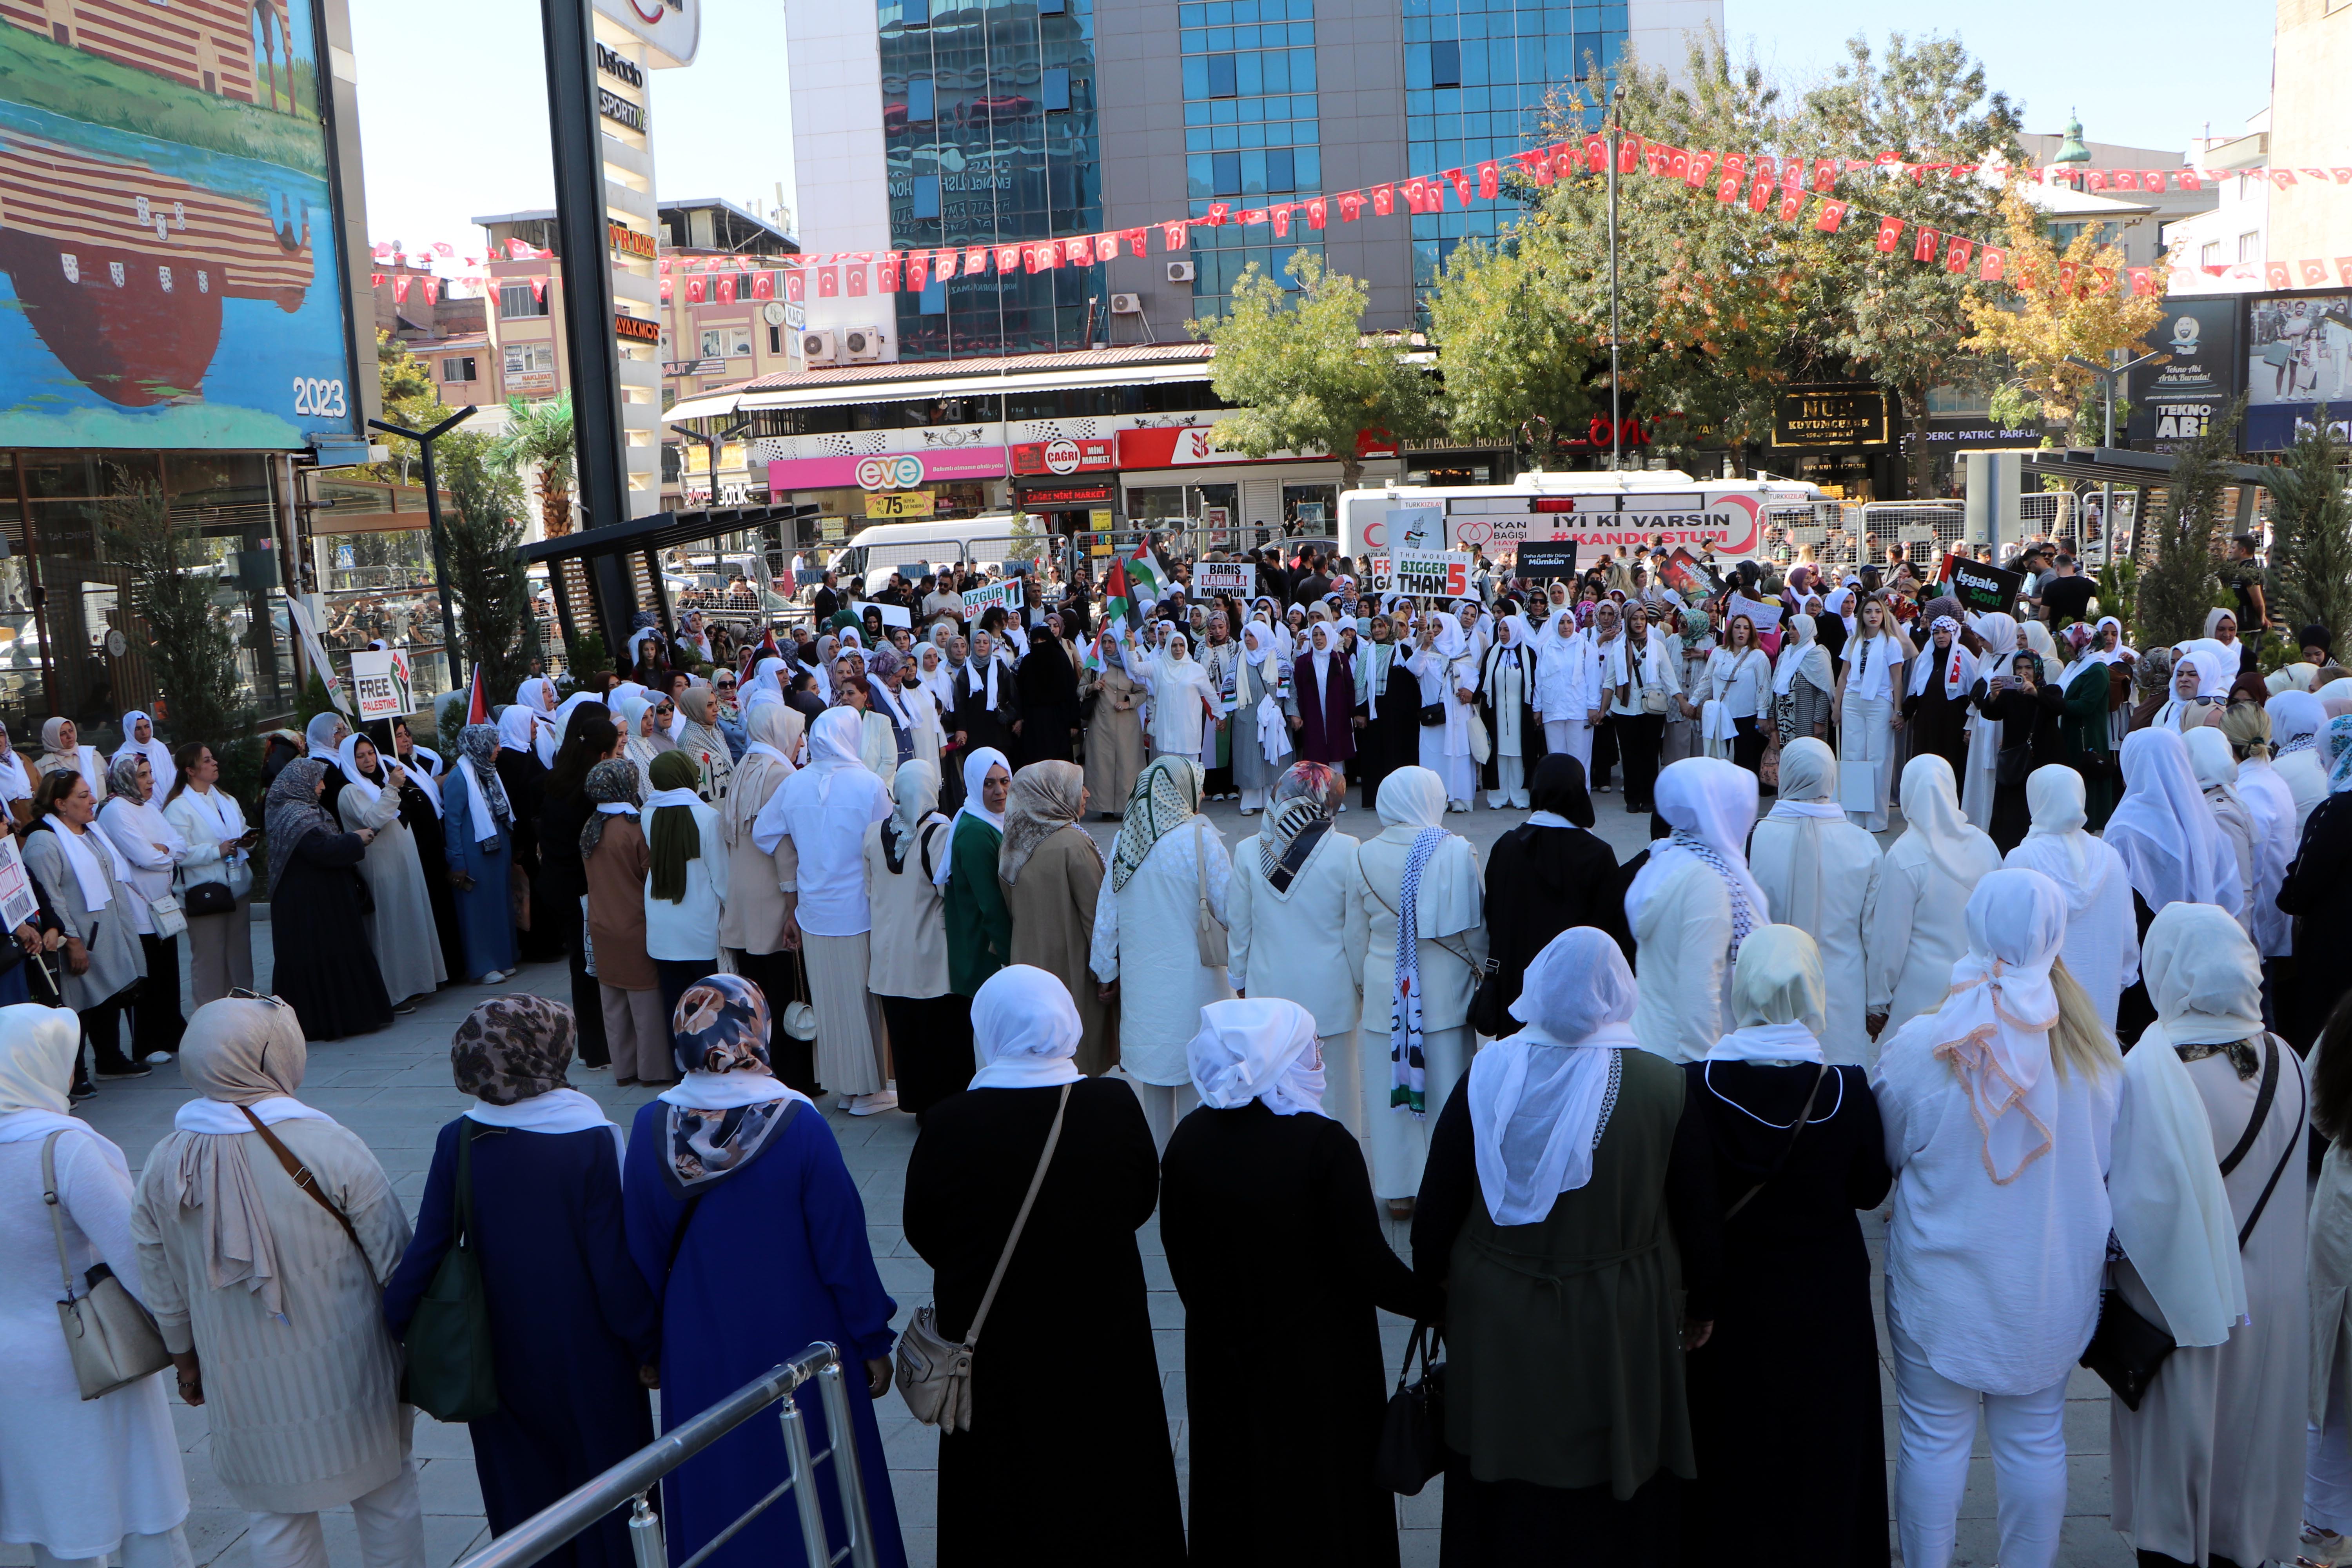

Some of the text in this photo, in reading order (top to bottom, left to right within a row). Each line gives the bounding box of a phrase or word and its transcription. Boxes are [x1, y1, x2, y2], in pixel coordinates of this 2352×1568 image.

[597, 43, 642, 88] DeFacto
[609, 224, 630, 250] MR
[2165, 365, 2201, 374] Tekno Abi
[2158, 373, 2211, 383] Artık Burada!
[294, 377, 347, 418] 2023
[2158, 405, 2211, 416] TEKNO
[1788, 419, 1870, 430] KUYUMCULUK
[1959, 430, 1995, 439] PATRIC
[1047, 450, 1078, 464] ÇAĞRI
[1087, 445, 1104, 455] MİNİ
[1082, 456, 1111, 465] MARKET
[859, 457, 920, 487] eve
[1027, 490, 1106, 502] ÇAĞRI MİNİ MARKET
[884, 496, 903, 514] 75
[1553, 513, 1730, 528] İYİ Kİ VARSIN
[1494, 530, 1527, 540] BAĞIŞI
[1210, 564, 1241, 575] BARIŞ
[1374, 560, 1391, 574] FR
[1401, 561, 1447, 574] BIGGER
[1690, 563, 1711, 581] FİLİSTİN
[700, 574, 728, 587] POLİS
[799, 570, 823, 584] POLİS
[1203, 575, 1245, 585] KADINLA
[1397, 563, 1466, 595] THAN 5
[1956, 567, 1998, 592] İşgale
[1201, 586, 1246, 597] MÜMKÜN
[1694, 575, 1717, 594] OLACAK
[964, 587, 1003, 606] ÖZGÜR
[1969, 588, 2002, 606] Son!
[359, 678, 390, 699] FREE
[362, 698, 397, 712] PALESTINE
